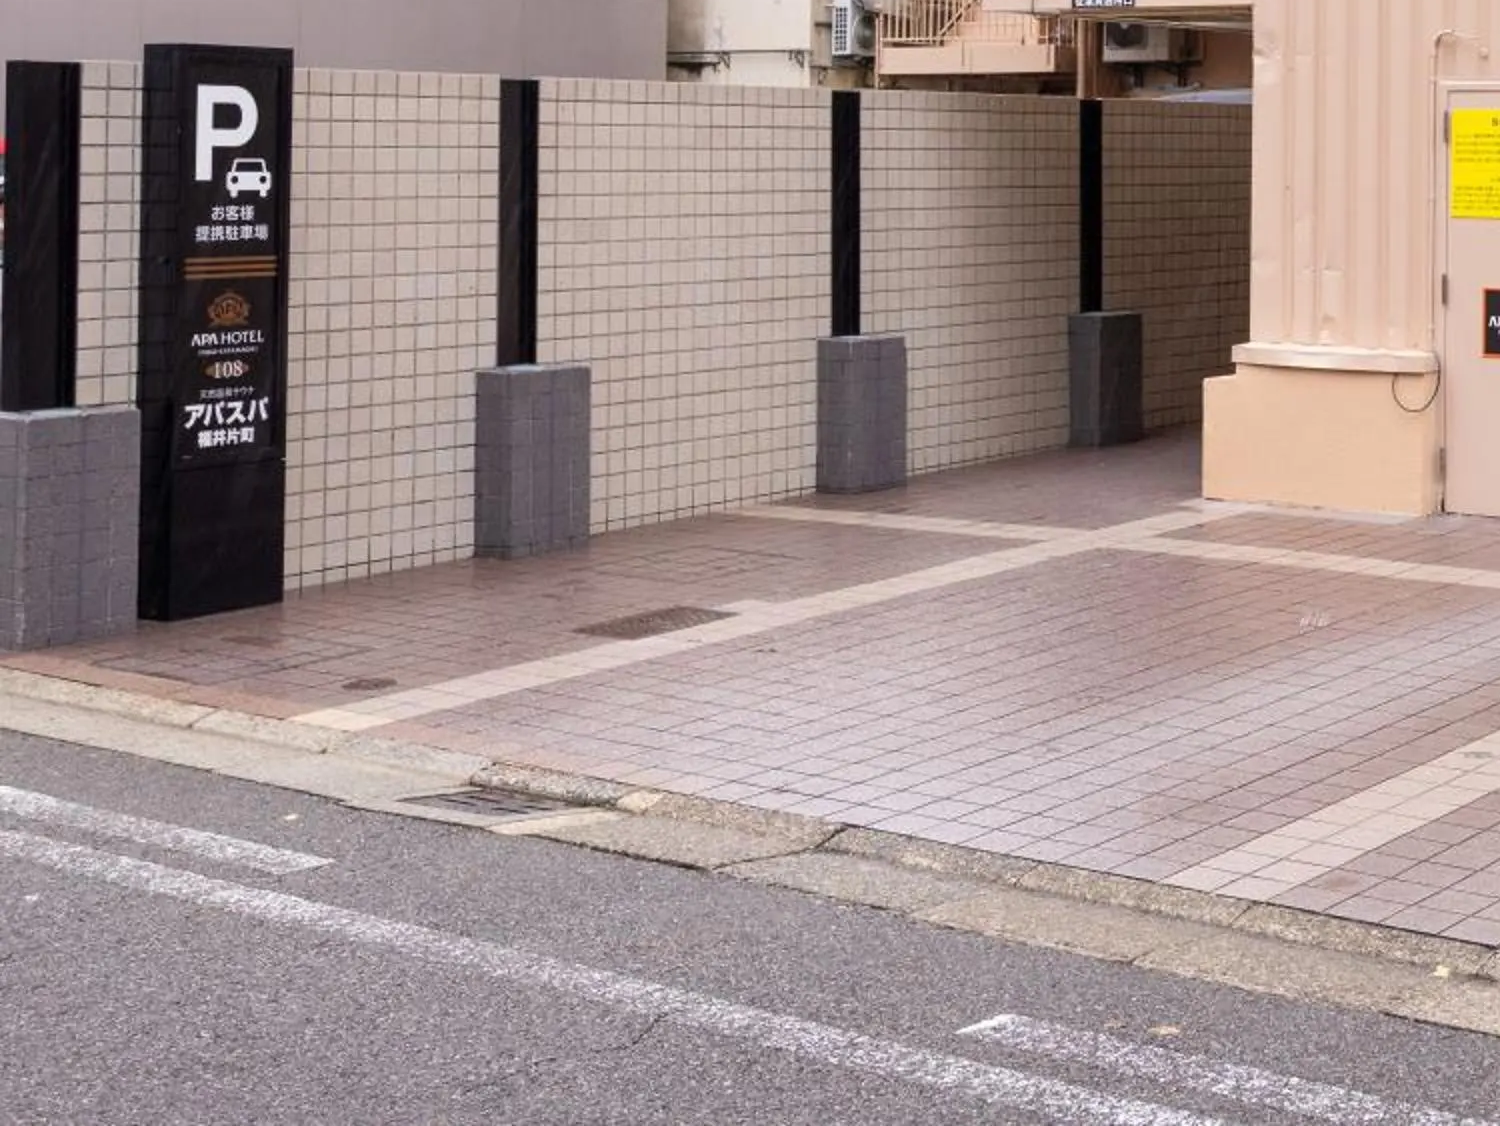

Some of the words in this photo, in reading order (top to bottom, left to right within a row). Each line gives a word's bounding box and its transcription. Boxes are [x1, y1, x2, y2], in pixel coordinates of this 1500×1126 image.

[195, 84, 259, 181] P
[211, 205, 255, 222] お客様
[191, 333, 219, 347] APA
[221, 330, 265, 345] HOTEL
[198, 427, 255, 449] 福井片町
